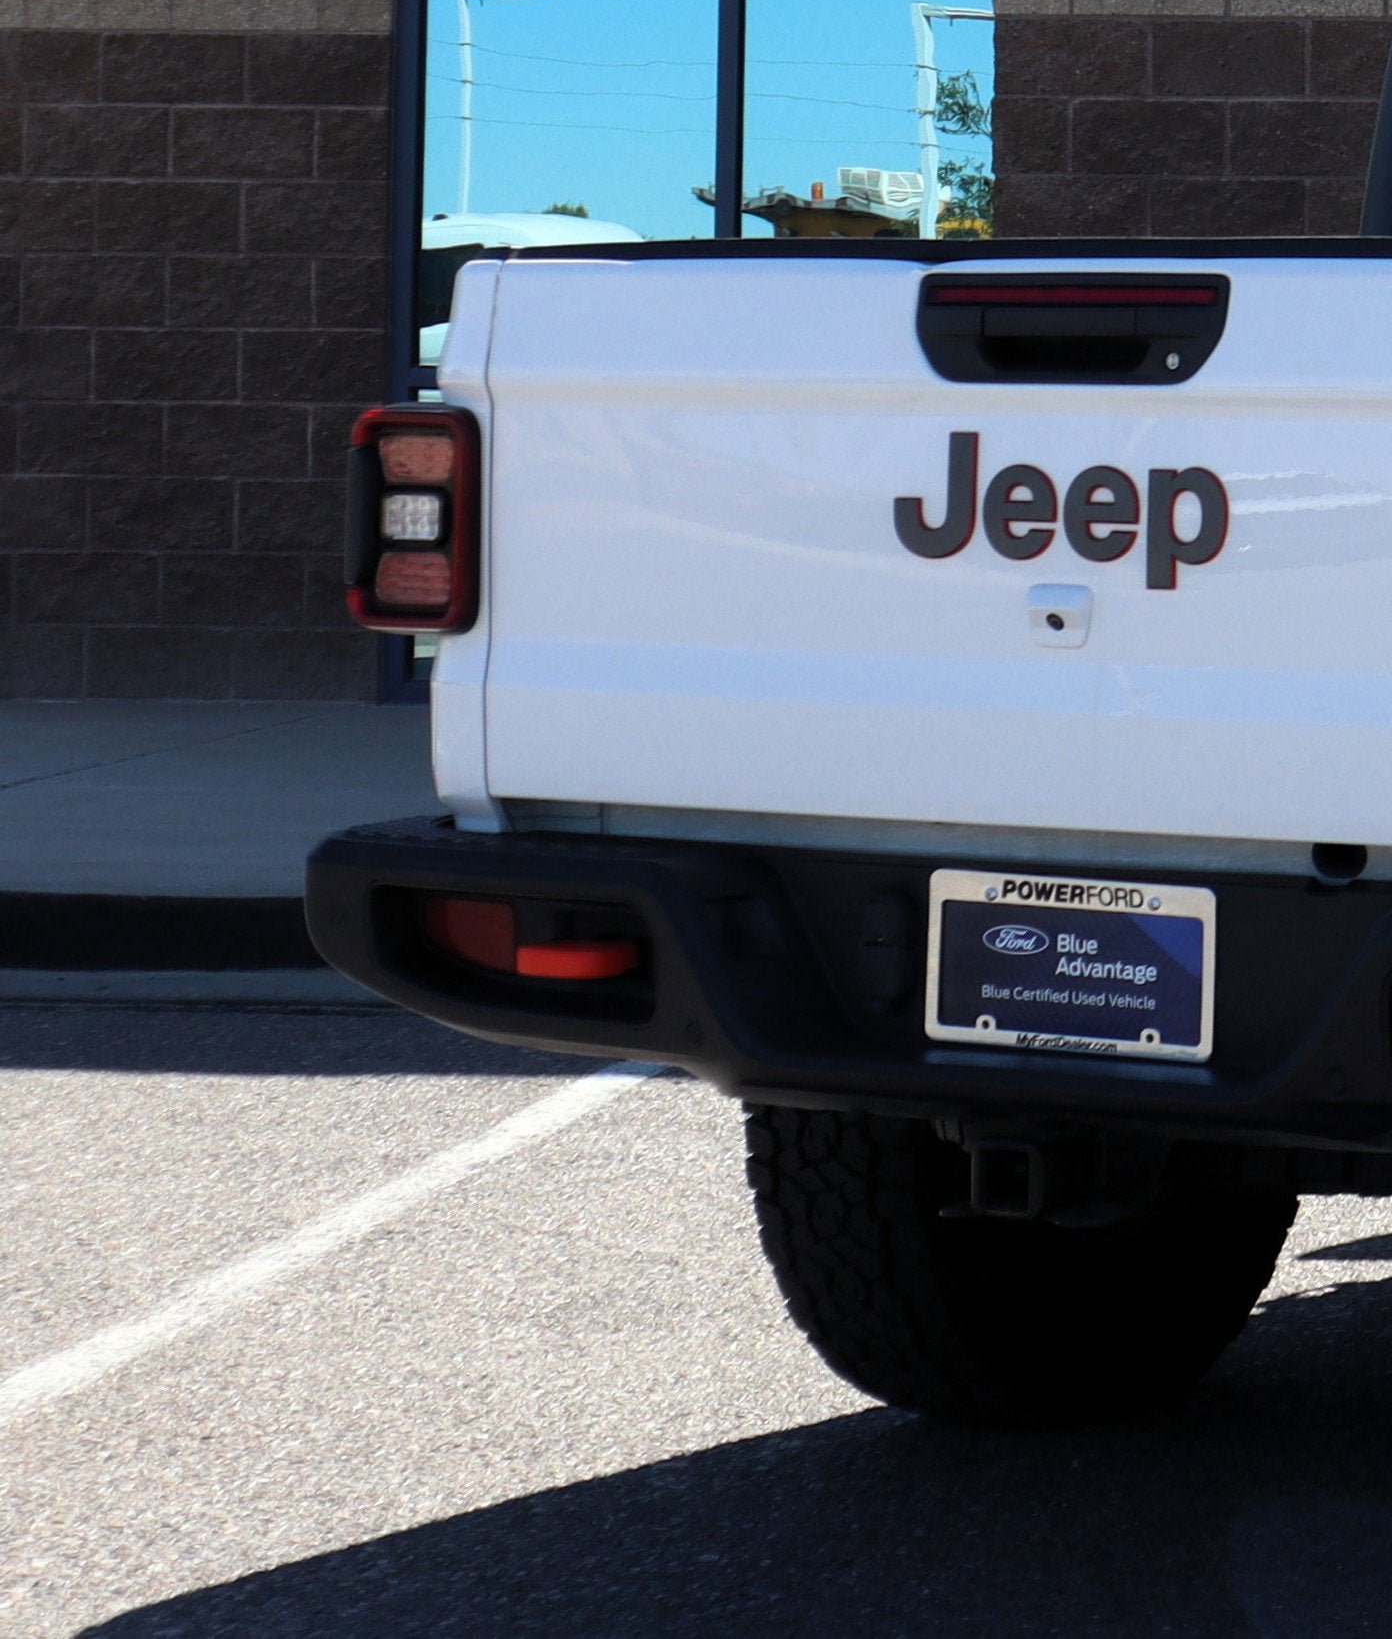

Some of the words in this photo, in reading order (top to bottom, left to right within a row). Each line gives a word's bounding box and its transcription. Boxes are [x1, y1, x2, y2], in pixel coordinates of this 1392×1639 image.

[893, 430, 1230, 590] Jeep
[1001, 879, 1144, 909] POWERFORD
[994, 928, 1038, 951] Ford
[1056, 933, 1099, 955] Blue
[1055, 956, 1158, 985] Advantage
[981, 984, 1011, 1000] Blue
[1013, 986, 1070, 1004] Certified
[1072, 991, 1106, 1007] Used
[1108, 993, 1157, 1011] Vehicle
